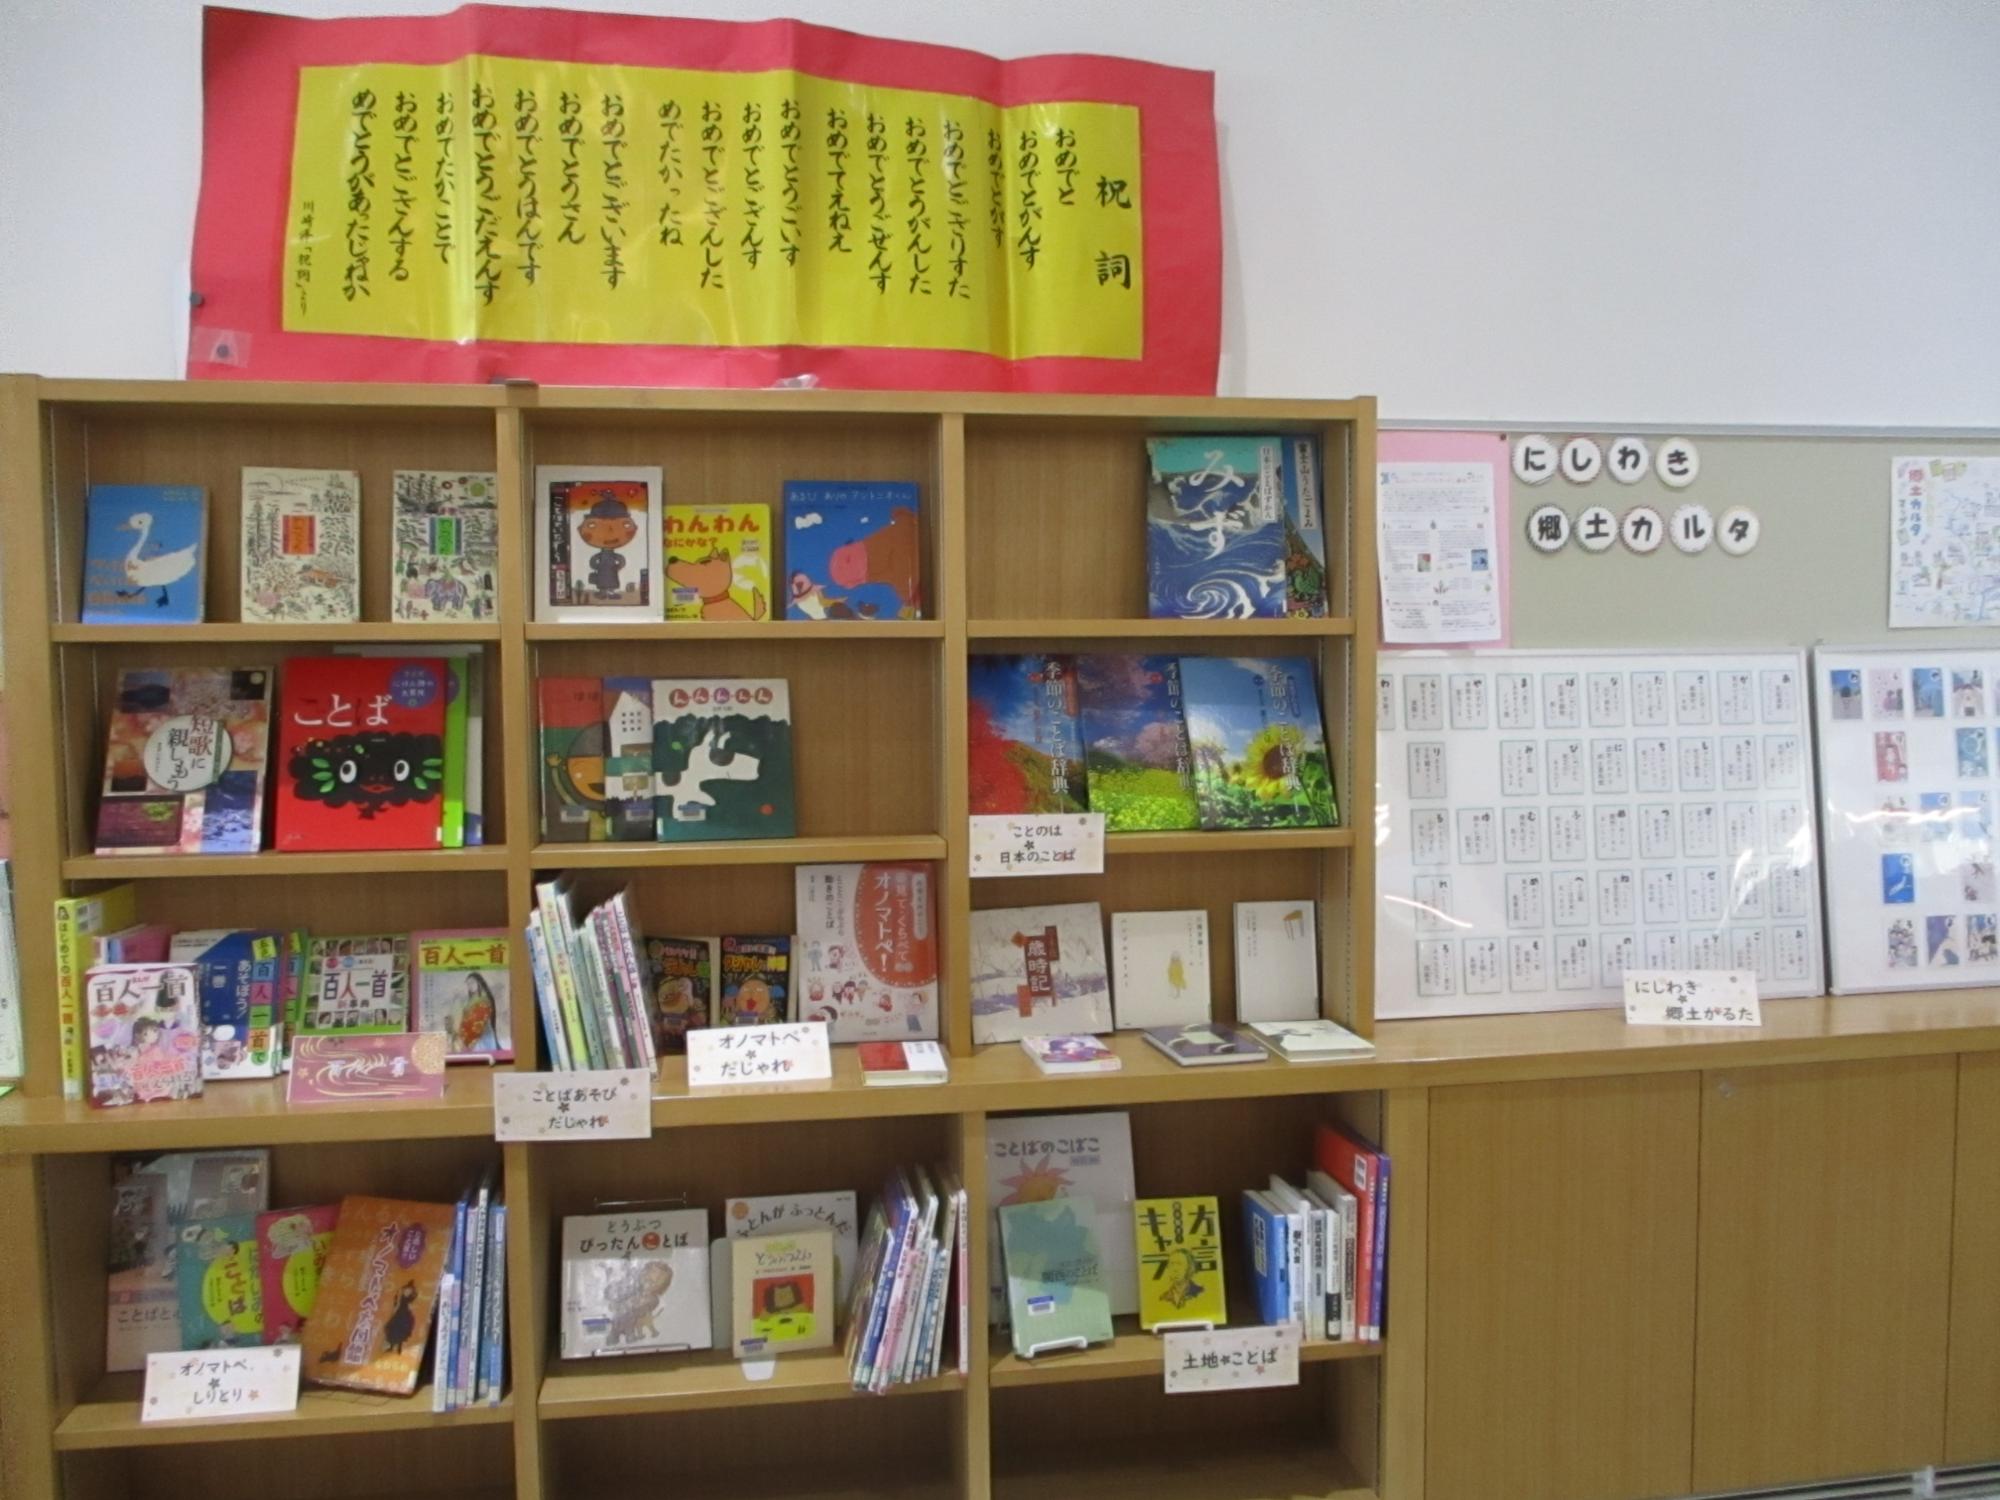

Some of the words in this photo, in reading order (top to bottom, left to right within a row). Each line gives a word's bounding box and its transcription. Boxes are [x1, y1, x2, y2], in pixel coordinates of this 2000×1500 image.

[558, 91, 585, 244] おめでとうさん
[659, 100, 683, 246] めでたかったね
[827, 108, 852, 253] おめでてえねえ
[1055, 128, 1079, 206] おめでと
[514, 88, 543, 286] おめでとうはんです
[601, 94, 630, 290] おめでとございます
[700, 101, 726, 289] おめでとござんした
[741, 102, 765, 269] おめでとござんす
[1018, 130, 1042, 271] おめでとがんす
[867, 113, 893, 295] おめでとうごぜんす
[906, 116, 932, 295] おめでとうがんした
[1096, 174, 1132, 290] 祝詞
[1524, 446, 1690, 476] にしわき
[664, 514, 760, 533] わんわん
[1537, 513, 1750, 542] 郷土カルタ
[294, 694, 393, 727] ことば
[188, 715, 215, 769] 短歌に
[167, 728, 189, 792] 親しもう
[1012, 825, 1062, 838] ことのは
[999, 847, 1076, 863] 日本のことば
[874, 872, 893, 972] オノマトペ！
[422, 944, 507, 967] 百人一首
[1027, 941, 1051, 992] 歳時記
[93, 973, 188, 1003] 百人一首
[322, 970, 389, 1000] 百人一首
[1634, 980, 1699, 994] にしわき
[719, 1030, 801, 1048] オノマトペ
[720, 1060, 790, 1078] だじゃれ
[531, 1086, 619, 1103] ことばあそび
[548, 1114, 605, 1130] だじゃれ
[994, 1137, 1099, 1157] ことばのこばこ
[607, 1218, 661, 1233] どうぶつ
[1188, 1205, 1218, 1271] 方言
[1138, 1208, 1171, 1280] キャラ
[180, 1359, 249, 1375] オノマトペ
[1183, 1350, 1219, 1369] 土地
[1231, 1347, 1278, 1364] ことば
[192, 1388, 243, 1404] しりとり
